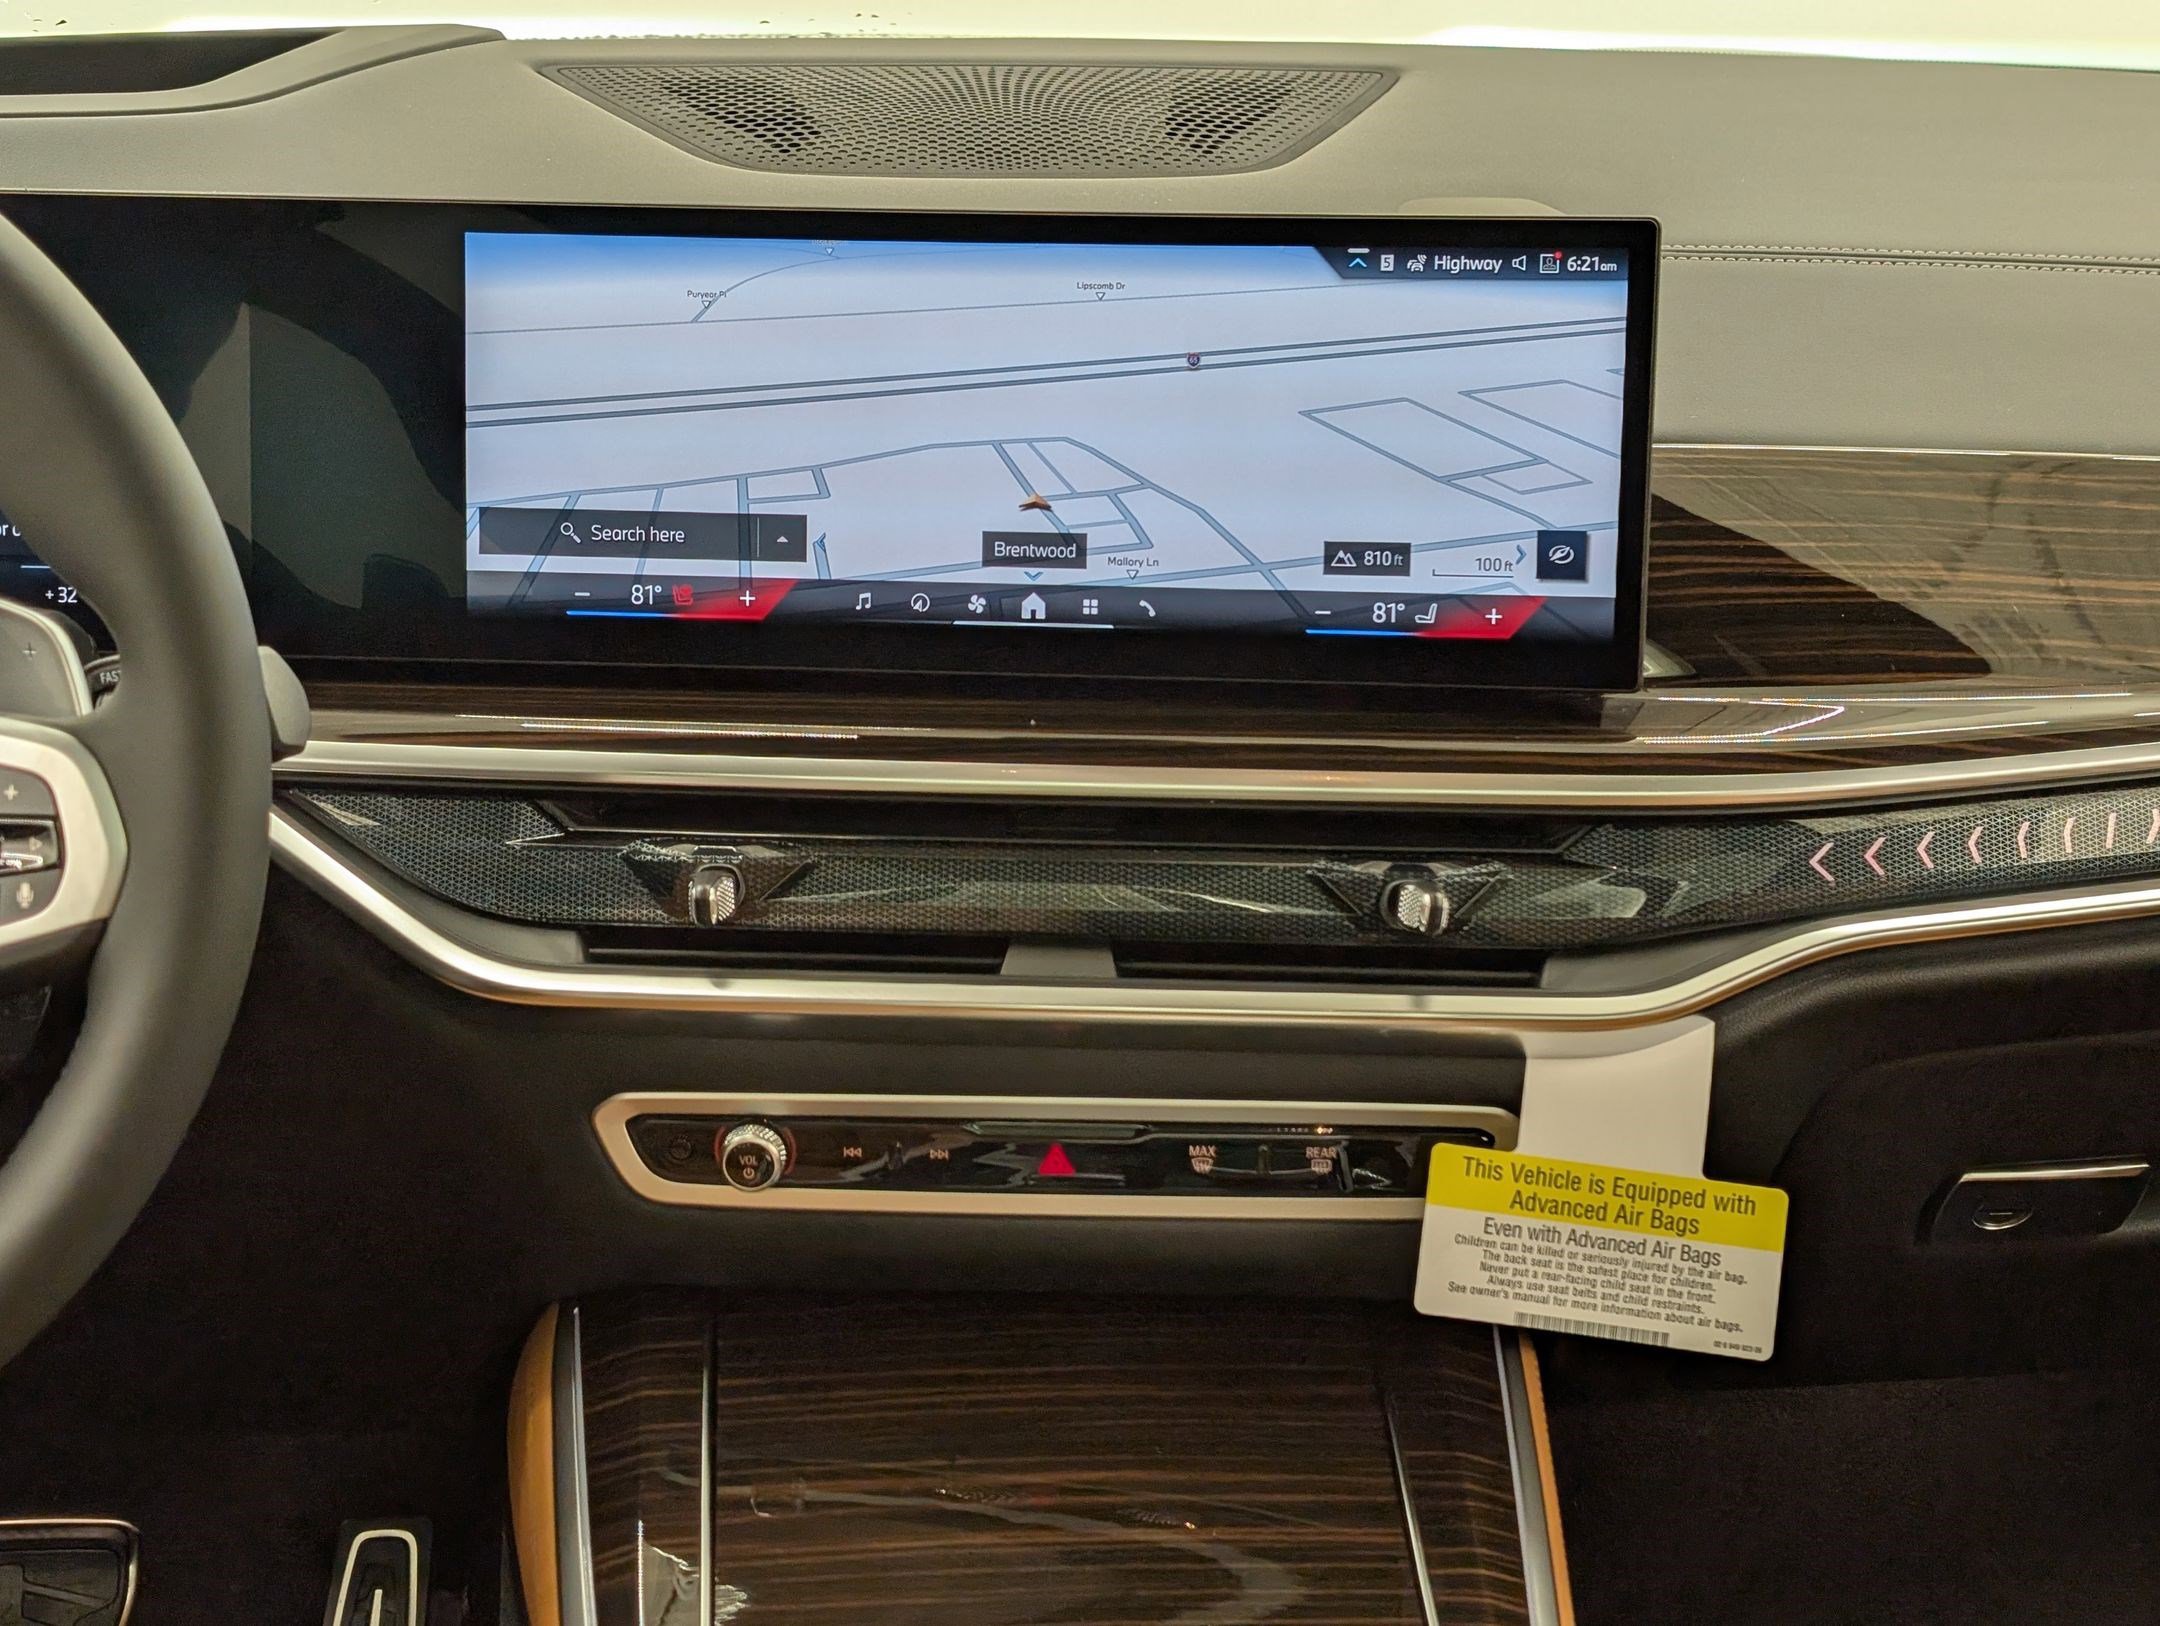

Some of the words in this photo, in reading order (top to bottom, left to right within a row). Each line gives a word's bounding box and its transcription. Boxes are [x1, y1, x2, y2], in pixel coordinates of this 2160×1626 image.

[1434, 255, 1502, 273] Highway
[1567, 255, 1618, 272] 6:21am
[687, 290, 717, 299] Puryear
[1076, 282, 1114, 290] Lipscomb
[1116, 282, 1126, 290] Dr
[591, 524, 646, 541] Search
[650, 526, 685, 543] here
[994, 541, 1077, 558] Brentwood
[1363, 551, 1392, 566] 810
[1394, 553, 1403, 566] ft
[1107, 556, 1144, 568] Mallory
[1146, 558, 1159, 567] Ln
[1475, 557, 1501, 572] 100
[1503, 561, 1514, 572] ft
[631, 584, 662, 605] 81°
[1372, 602, 1406, 623] 81°
[739, 1154, 758, 1166] VOL
[1189, 1145, 1217, 1157] MAX
[1306, 1147, 1337, 1159] REAR
[1463, 1156, 1503, 1181] This
[1511, 1163, 1582, 1191] Vehicle
[1588, 1173, 1605, 1194] is
[1612, 1176, 1706, 1209] Equipped
[1713, 1193, 1757, 1216] with
[1509, 1190, 1608, 1221] Advanced
[1614, 1204, 1644, 1226] Air
[1650, 1208, 1700, 1237] Bags
[1483, 1217, 1522, 1239] Even
[1527, 1224, 1562, 1244] with
[1565, 1228, 1647, 1256] Advanced
[1651, 1240, 1676, 1259] Air
[1680, 1244, 1721, 1268] Bags
[1454, 1233, 1497, 1248] Children
[1500, 1241, 1519, 1252] can
[1521, 1243, 1534, 1254] be
[1536, 1244, 1564, 1258] killed
[1567, 1250, 1579, 1260] or
[1582, 1251, 1629, 1268] seriously
[1632, 1258, 1668, 1273] injured
[1672, 1264, 1685, 1276] by
[1688, 1265, 1704, 1278] the
[1707, 1268, 1722, 1280] air
[1724, 1271, 1748, 1286] bag.
[1483, 1249, 1500, 1261] The
[1504, 1251, 1527, 1265] back
[1530, 1256, 1552, 1269] seat
[1554, 1259, 1564, 1270] is
[1568, 1260, 1584, 1272] the
[1587, 1263, 1618, 1278] safest
[1621, 1268, 1649, 1282] place
[1651, 1273, 1667, 1284] for
[1670, 1274, 1716, 1292] children.
[1480, 1261, 1509, 1275] Never
[1512, 1266, 1529, 1278] put
[1531, 1270, 1539, 1279] a
[1541, 1272, 1598, 1289] rear-facing
[1601, 1279, 1626, 1291] child
[1629, 1282, 1651, 1295] seat
[1653, 1286, 1664, 1296] in
[1667, 1287, 1684, 1299] the
[1687, 1289, 1716, 1304] front.
[1486, 1274, 1523, 1289] Always
[1526, 1281, 1544, 1291] use
[1547, 1282, 1570, 1295] seat
[1572, 1286, 1598, 1300] belts
[1600, 1291, 1620, 1302] and
[1623, 1293, 1649, 1306] child
[1651, 1298, 1705, 1314] restraints.
[1448, 1280, 1466, 1293] See
[1469, 1286, 1509, 1299] owner's
[1512, 1291, 1550, 1305] manual
[1553, 1295, 1568, 1307] for
[1571, 1300, 1598, 1312] more
[1601, 1303, 1662, 1320] information
[1664, 1312, 1694, 1325] about
[1697, 1316, 1712, 1328] air
[1714, 1319, 1743, 1333] bags.
